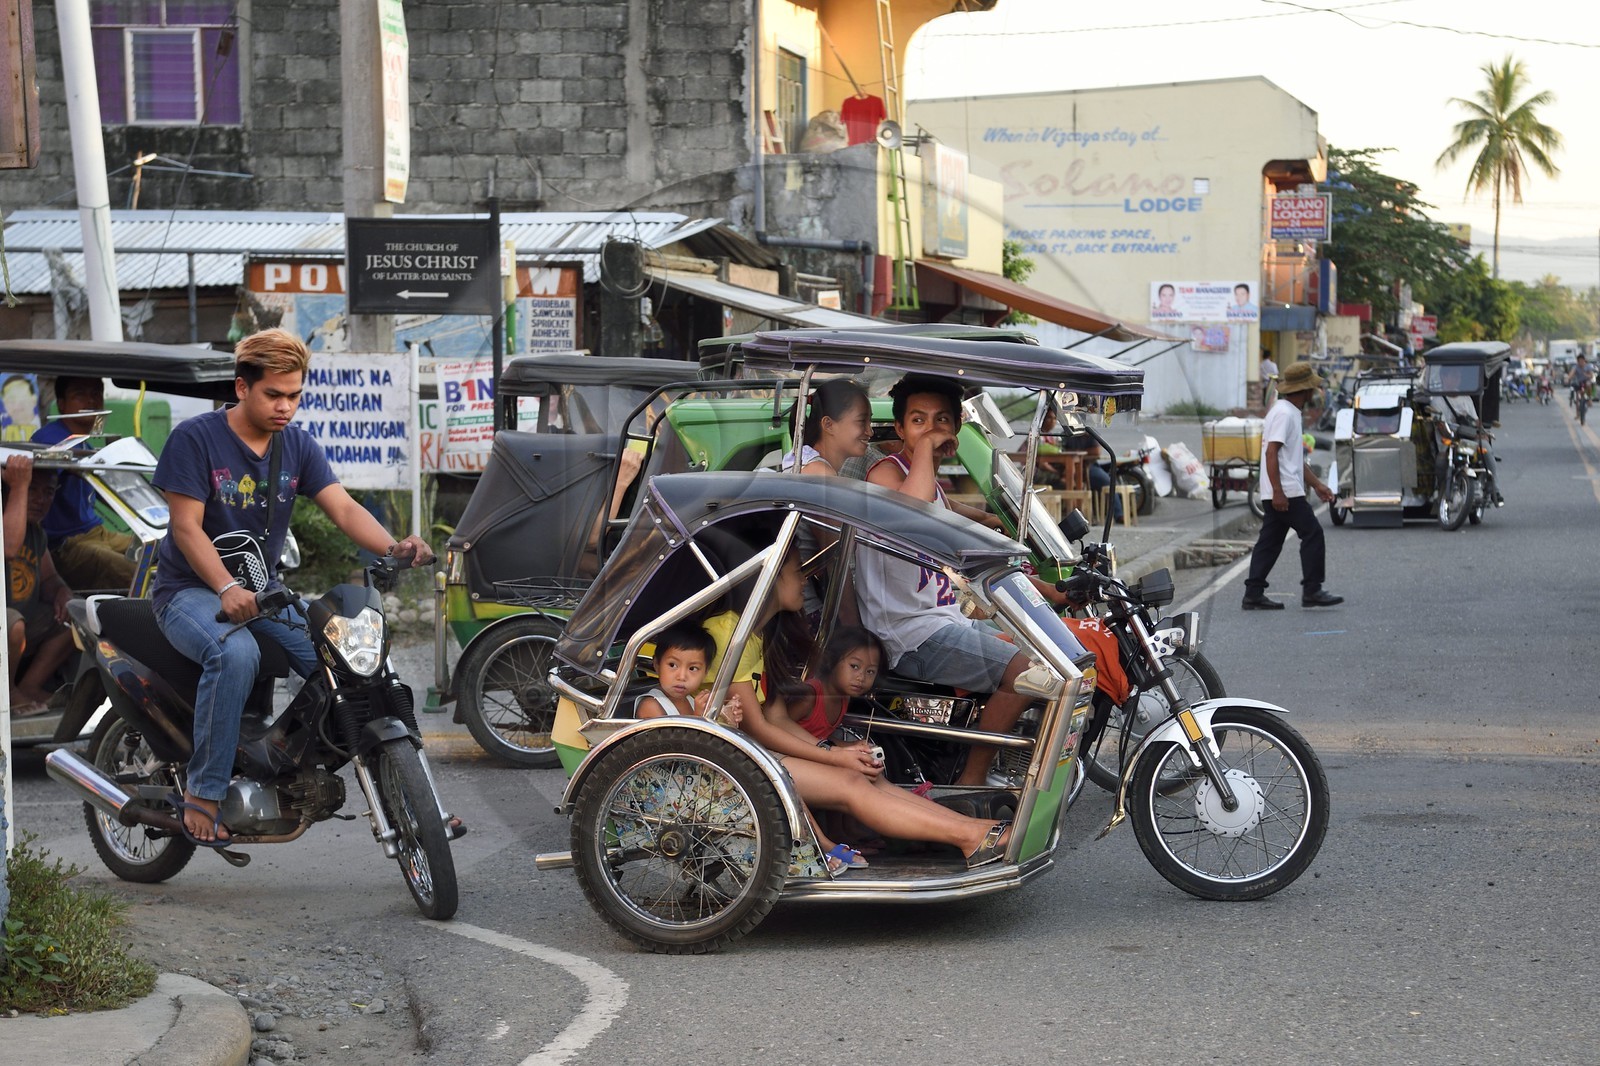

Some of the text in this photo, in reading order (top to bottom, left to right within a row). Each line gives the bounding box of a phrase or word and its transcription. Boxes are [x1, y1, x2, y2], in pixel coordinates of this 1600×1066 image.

[983, 128, 1023, 143] When
[1102, 127, 1137, 147] stay
[999, 158, 1185, 202] Solano
[1123, 197, 1203, 213] LODGE
[1273, 199, 1324, 211] SOLANO
[1273, 210, 1322, 220] LODGE
[1050, 229, 1106, 240] PARKING
[385, 242, 459, 252] THE CHURCH OF
[1075, 243, 1104, 254] BACK
[365, 254, 479, 271] JESUS CHRIST
[372, 272, 386, 280] OF
[441, 273, 473, 281] SAINTS
[531, 299, 570, 309] GUIDEBAR
[532, 309, 574, 318] SAWCHAIN
[531, 319, 570, 328] SPROCKET
[531, 329, 571, 338] ADHESIVE
[308, 368, 393, 387] MALINIS NA
[444, 378, 494, 403] B1N
[299, 392, 382, 412] APALIGIRAN
[446, 404, 466, 413] FOR
[308, 421, 325, 439] AY
[325, 445, 382, 465] NDAHAN
[915, 707, 943, 716] HONDA
